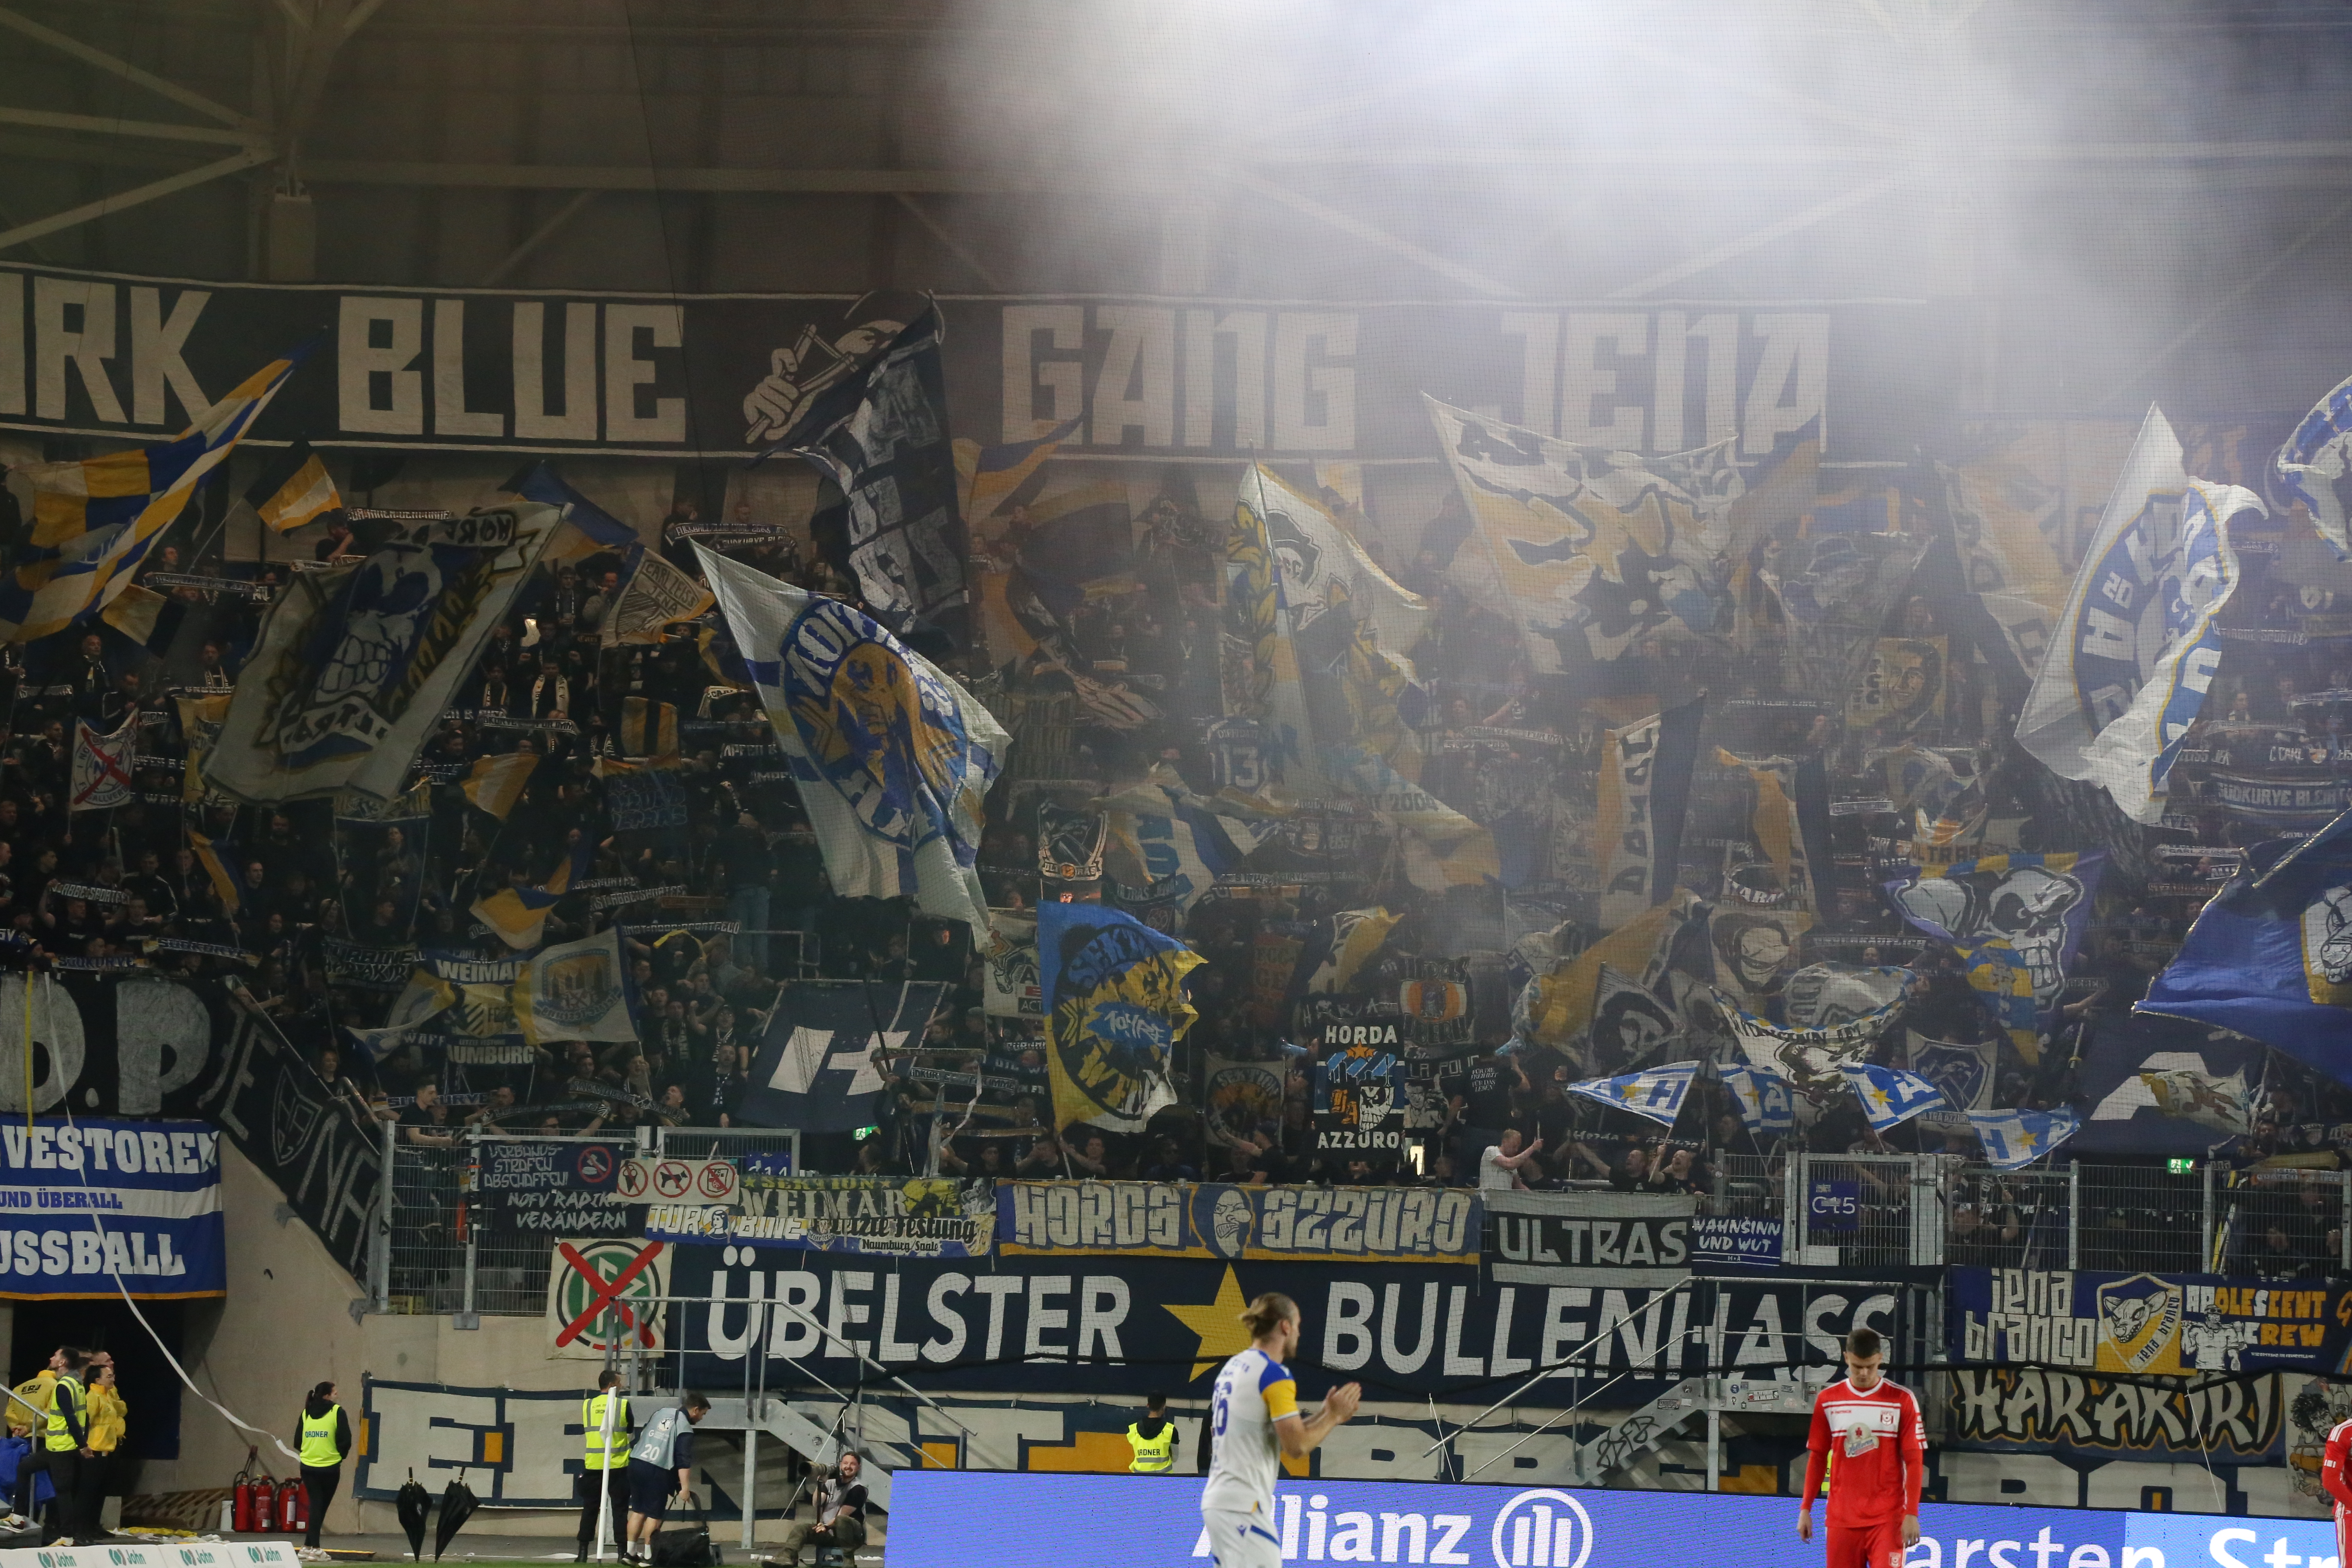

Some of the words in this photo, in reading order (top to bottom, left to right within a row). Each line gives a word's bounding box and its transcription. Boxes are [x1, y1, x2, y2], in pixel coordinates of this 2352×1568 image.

[0, 272, 212, 426] RK
[339, 296, 686, 445] BLUE
[1001, 303, 1359, 451] GANG
[1500, 308, 1830, 454] JENA
[646, 560, 671, 584] CARL
[670, 573, 700, 607] ZEISS
[646, 587, 679, 615] JENA
[1219, 744, 1258, 787] 13
[1325, 1025, 1398, 1044] HORDA
[1472, 1067, 1482, 1075] FÜR
[1482, 1066, 1495, 1074] DIE
[570, 1079, 632, 1103] NAUMBURG
[1216, 1067, 1281, 1100] SEKTION
[1471, 1079, 1484, 1088] FÜR
[1484, 1078, 1496, 1087] DAS
[1317, 1130, 1401, 1150] AZZURO
[493, 1157, 554, 1172] STRAFEN
[483, 1172, 569, 1188] ABSCHAFFEN!
[39, 1187, 123, 1210] ÜBERALL
[507, 1191, 553, 1208] NOFV
[739, 1187, 909, 1219] WEIMAR
[1812, 1195, 1856, 1216] C15
[515, 1210, 628, 1231] VERÄNDERN
[1261, 1189, 1472, 1253] AZZURO
[1692, 1217, 1781, 1236] WAHNSINN
[861, 1237, 940, 1253] Naumburg/Saale
[1498, 1216, 1687, 1265] ULTRAS
[1699, 1235, 1733, 1251] UND
[1737, 1238, 1772, 1253] WUT
[2187, 1284, 2326, 1319] ADOLESCENT
[707, 1244, 1130, 1367] ÜBELSTER
[1321, 1280, 1897, 1382] BULLENHASS
[2159, 1297, 2180, 1336] branco
[2244, 1322, 2326, 1347] CREW
[1957, 1369, 2274, 1447] HARAKIRI
[304, 1430, 328, 1438] ORDNER
[640, 1444, 660, 1461] 20
[1192, 1494, 1472, 1565] lianz
[126, 1550, 146, 1565] John
[196, 1549, 215, 1564] John
[264, 1547, 282, 1562] John
[1904, 1526, 2166, 1568] arsten
[55, 1553, 75, 1567] John
